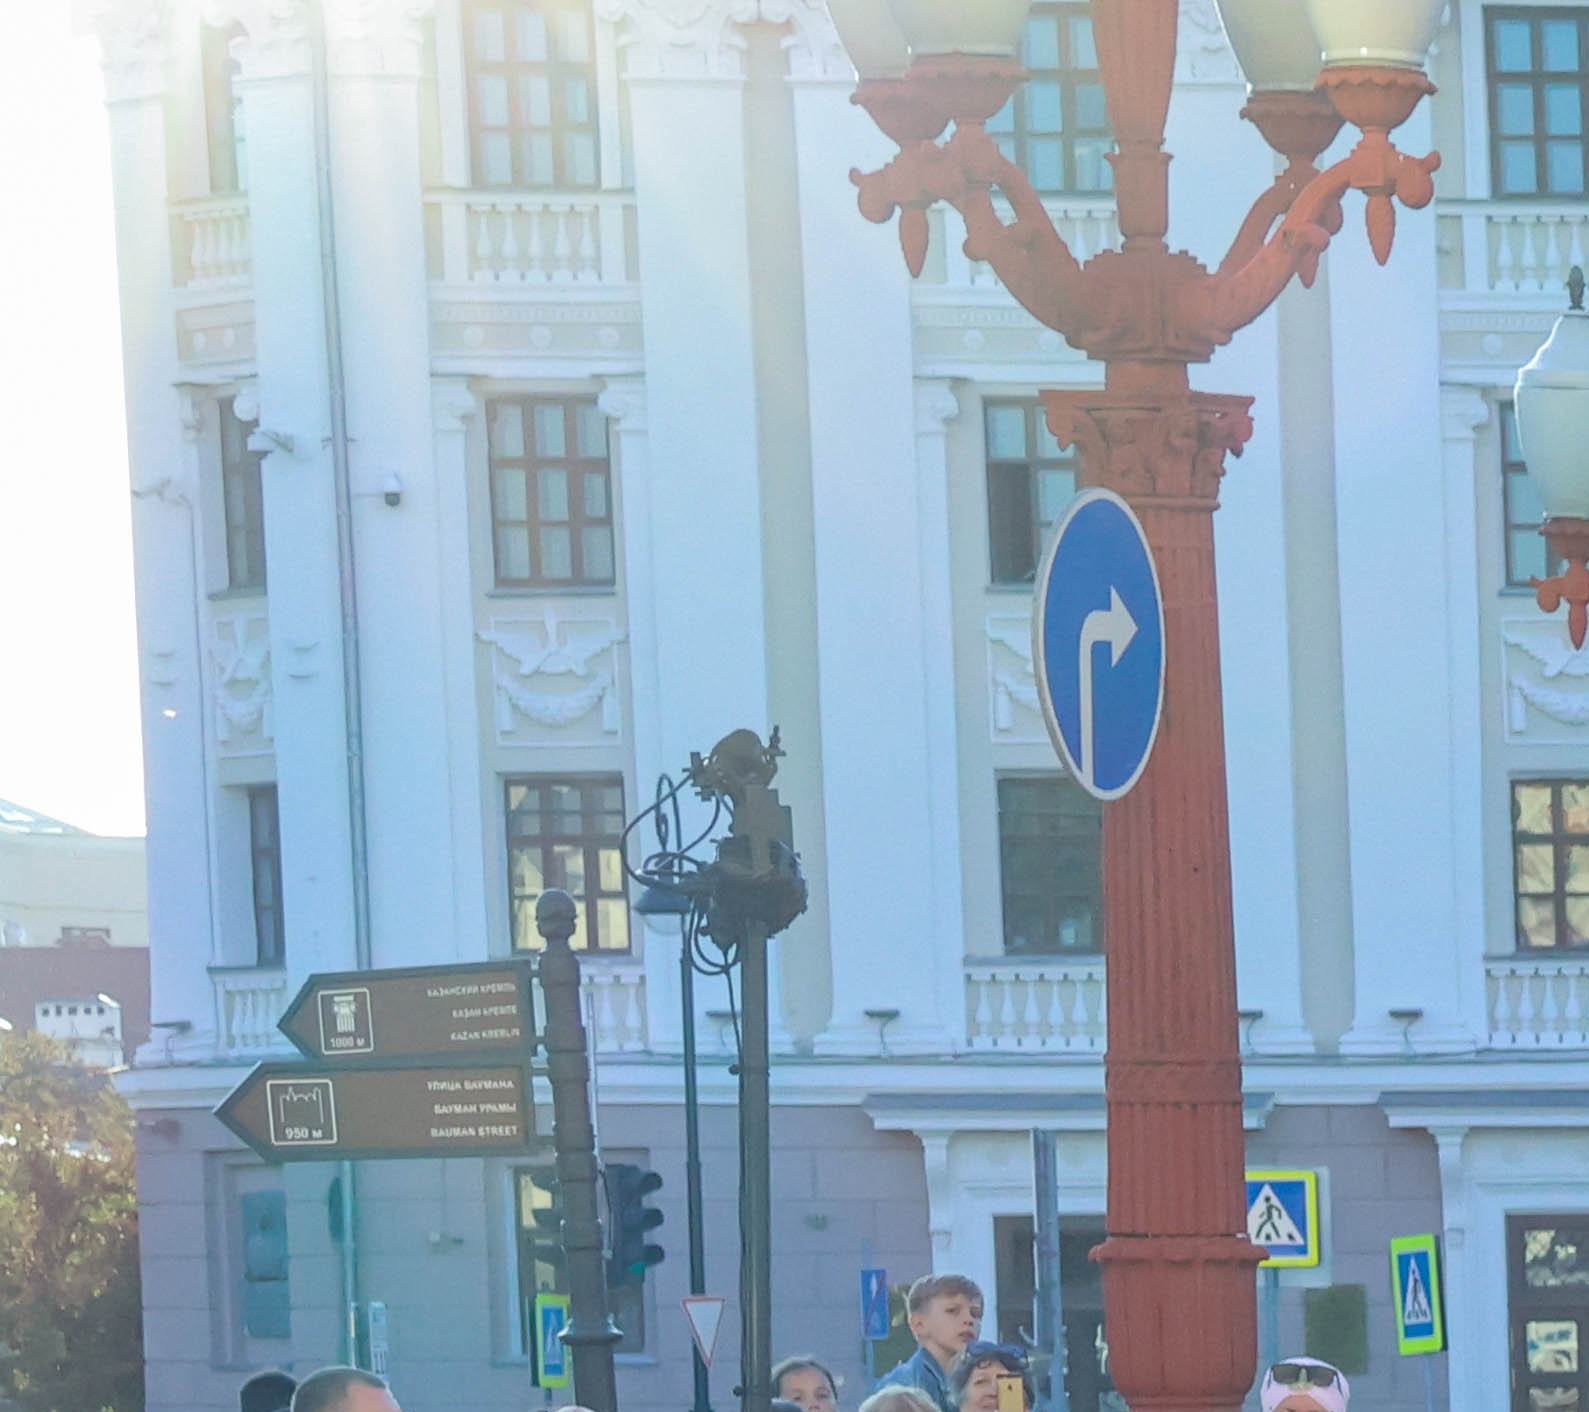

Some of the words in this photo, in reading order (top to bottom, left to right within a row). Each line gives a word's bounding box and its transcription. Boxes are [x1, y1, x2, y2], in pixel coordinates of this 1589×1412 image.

[434, 1103, 477, 1114] БАУМАН
[285, 1127, 309, 1140] 950
[430, 1127, 476, 1138] BAUMAN
[478, 1125, 518, 1137] STREET
